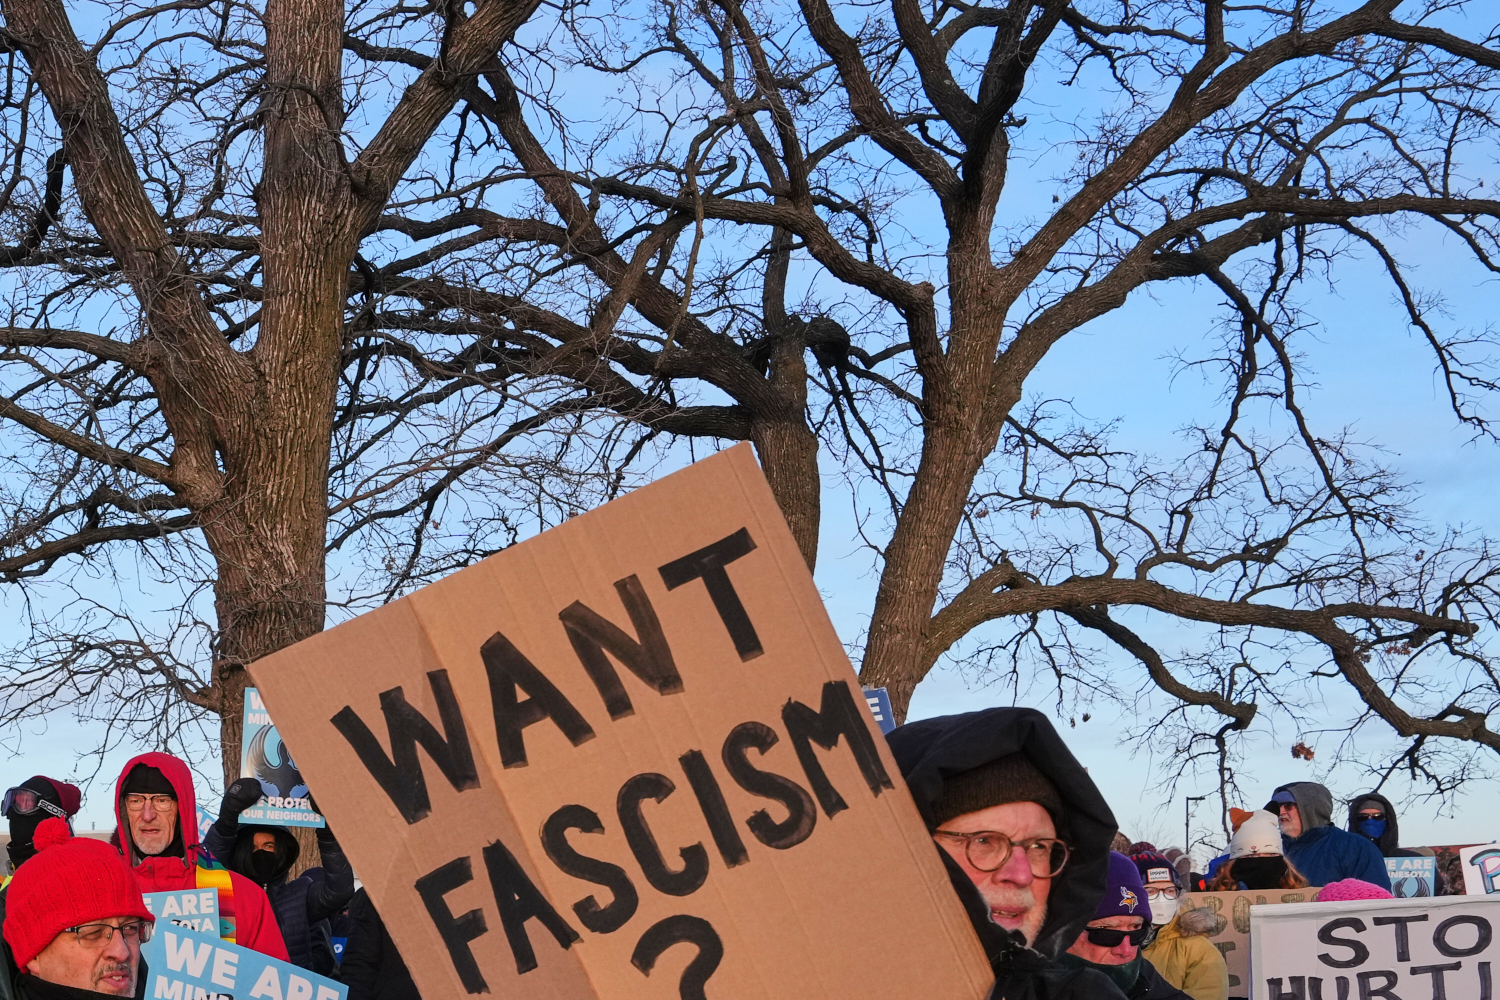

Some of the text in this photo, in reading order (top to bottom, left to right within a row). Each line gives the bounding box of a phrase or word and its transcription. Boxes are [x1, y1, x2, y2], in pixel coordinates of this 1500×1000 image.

[330, 527, 764, 824] WANT
[243, 809, 321, 822] OUR NEIGHBORS
[414, 681, 894, 995] FASCISM
[1401, 858, 1433, 869] ARE
[161, 892, 215, 918] ARE
[164, 931, 239, 990] WE
[1317, 913, 1493, 968] STO
